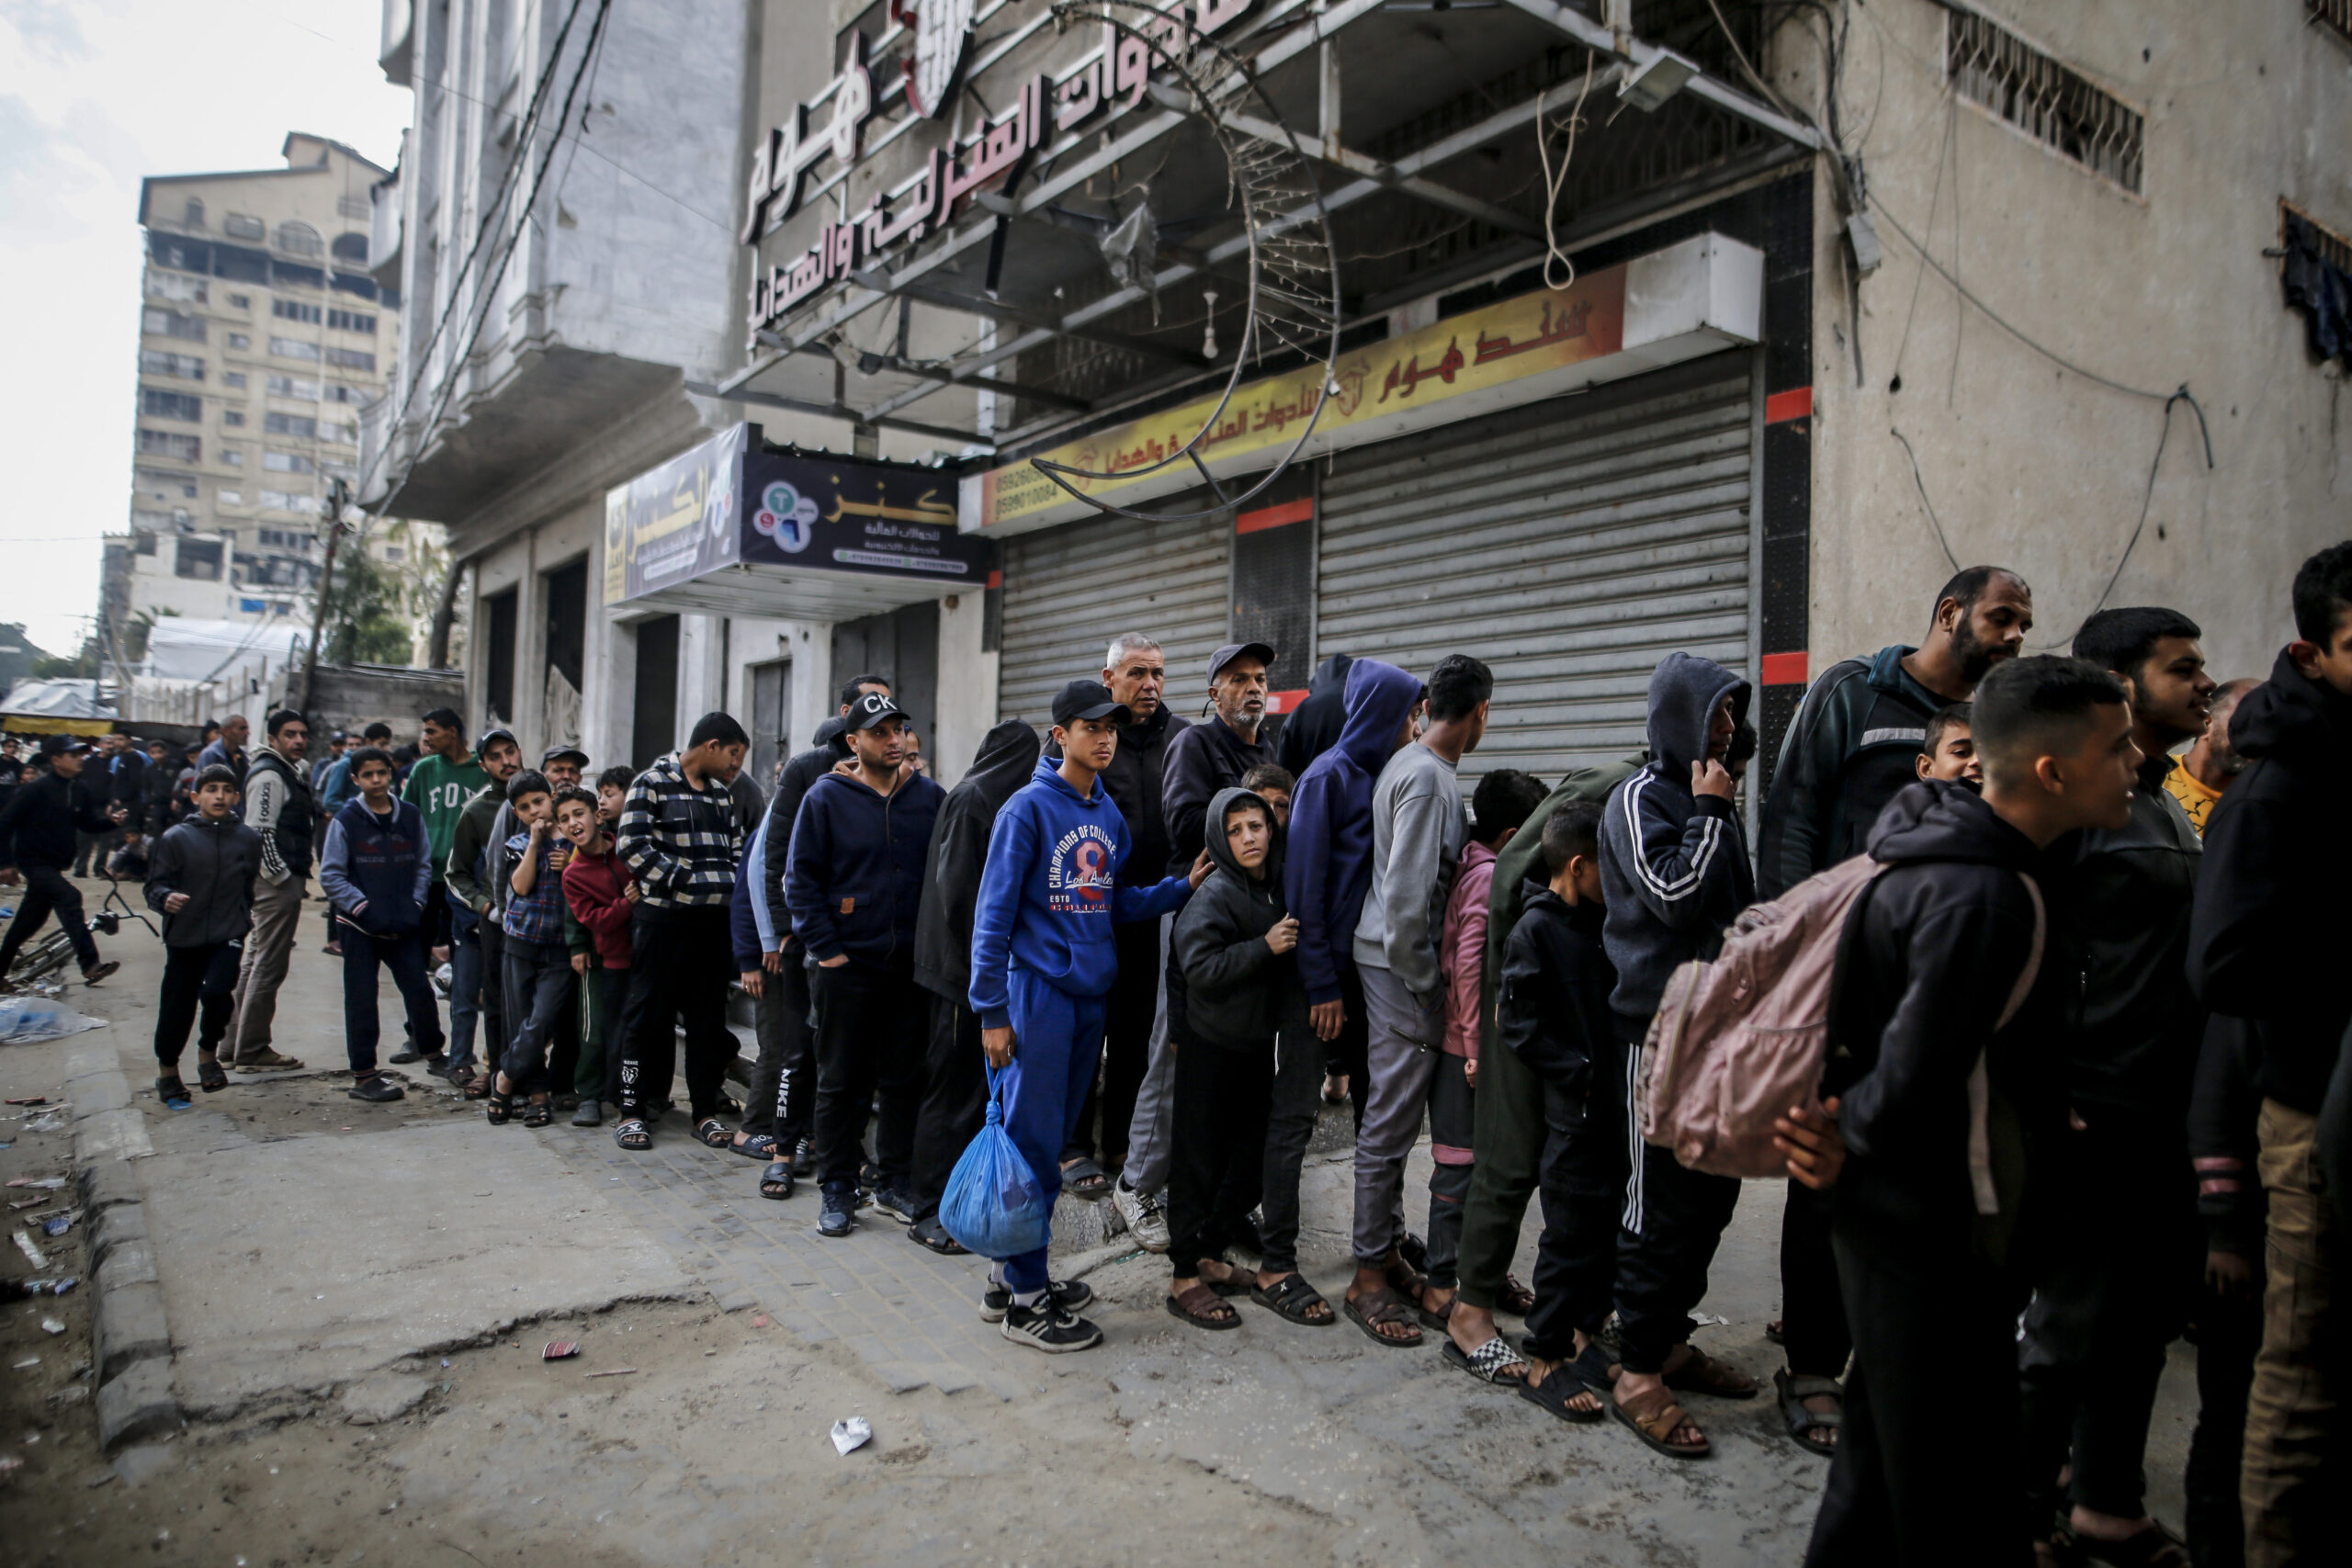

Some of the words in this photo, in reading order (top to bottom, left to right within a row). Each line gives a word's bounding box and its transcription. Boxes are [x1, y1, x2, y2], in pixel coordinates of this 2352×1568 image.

[741, 29, 871, 245] هوم
[1378, 334, 1464, 404] هوم
[864, 694, 898, 714] CK
[1049, 830, 1079, 888] CHAMPIONS
[1078, 825, 1088, 839] OF
[1090, 825, 1116, 855] COLLEGE
[1066, 870, 1085, 885] Los
[776, 1068, 791, 1118] NIKE
